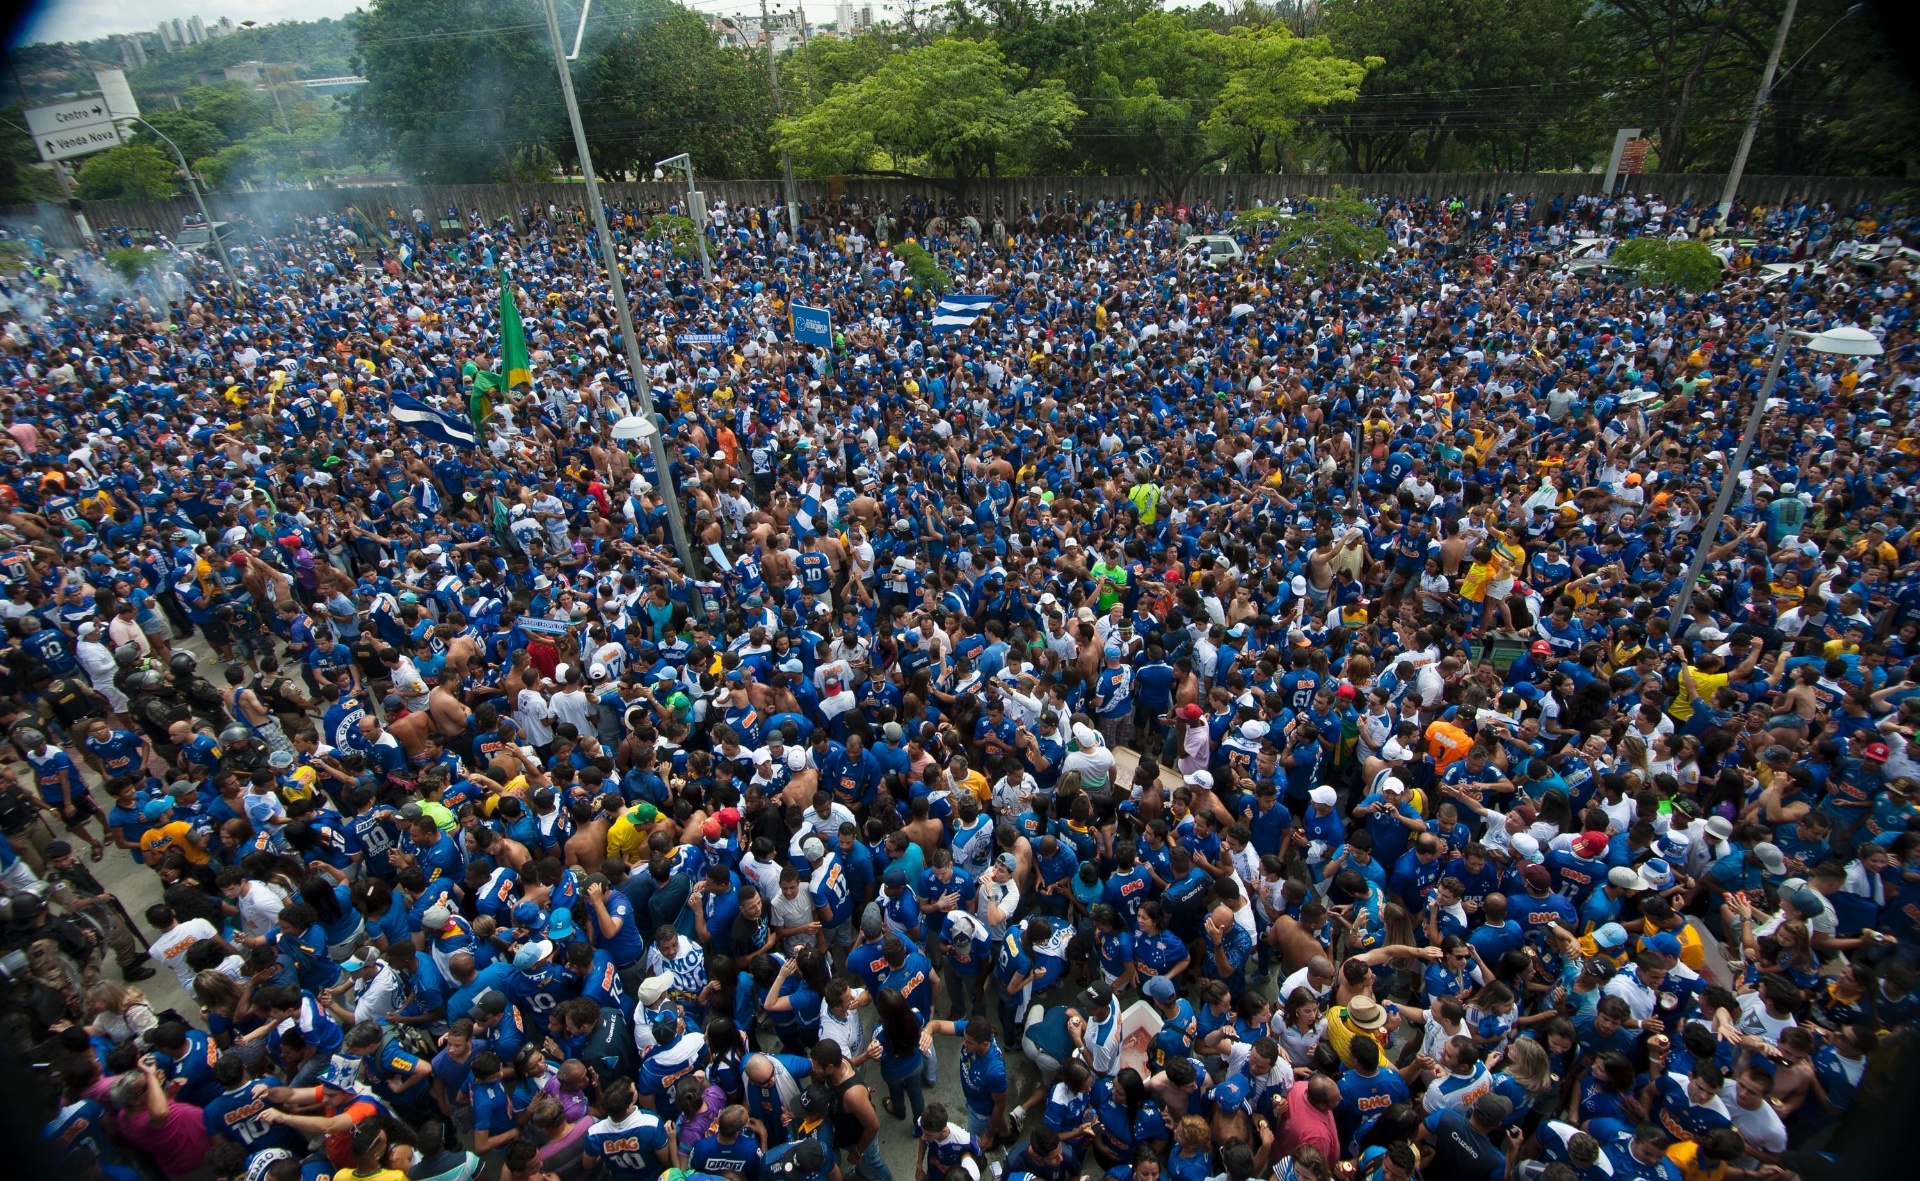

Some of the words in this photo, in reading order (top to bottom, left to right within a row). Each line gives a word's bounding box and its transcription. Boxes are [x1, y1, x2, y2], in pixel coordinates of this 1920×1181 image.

[56, 109, 88, 123] Centro
[56, 136, 88, 150] Venda
[89, 130, 114, 143] Nova
[1006, 322, 1014, 332] 10
[286, 362, 298, 372] 10
[624, 380, 632, 390] 11
[112, 419, 120, 430] 9
[62, 506, 78, 520] 10
[805, 568, 821, 582] 10
[968, 645, 983, 659] BMG
[607, 660, 621, 680] 17
[1298, 680, 1314, 688] BMG
[1293, 690, 1311, 708] 61
[481, 742, 503, 752] BMG
[444, 793, 466, 806] BMG
[362, 827, 388, 852] 10
[1418, 876, 1424, 886] 17
[1562, 868, 1590, 884] BMG
[498, 879, 513, 901] BMG
[1121, 879, 1143, 896] BMG
[1529, 912, 1559, 924] BMG
[164, 935, 197, 959] BMG
[602, 962, 614, 991] BMG
[610, 974, 623, 1003] 10
[901, 971, 924, 999] BMG
[526, 993, 556, 1012] 10
[1358, 1095, 1391, 1111] BMG
[1463, 1084, 1487, 1106] BMG
[225, 1100, 264, 1125] BMG
[232, 1118, 270, 1145] 10
[604, 1137, 639, 1154] BMG
[1451, 1132, 1478, 1158] Cruzeiro
[707, 1159, 745, 1171] FIAT
